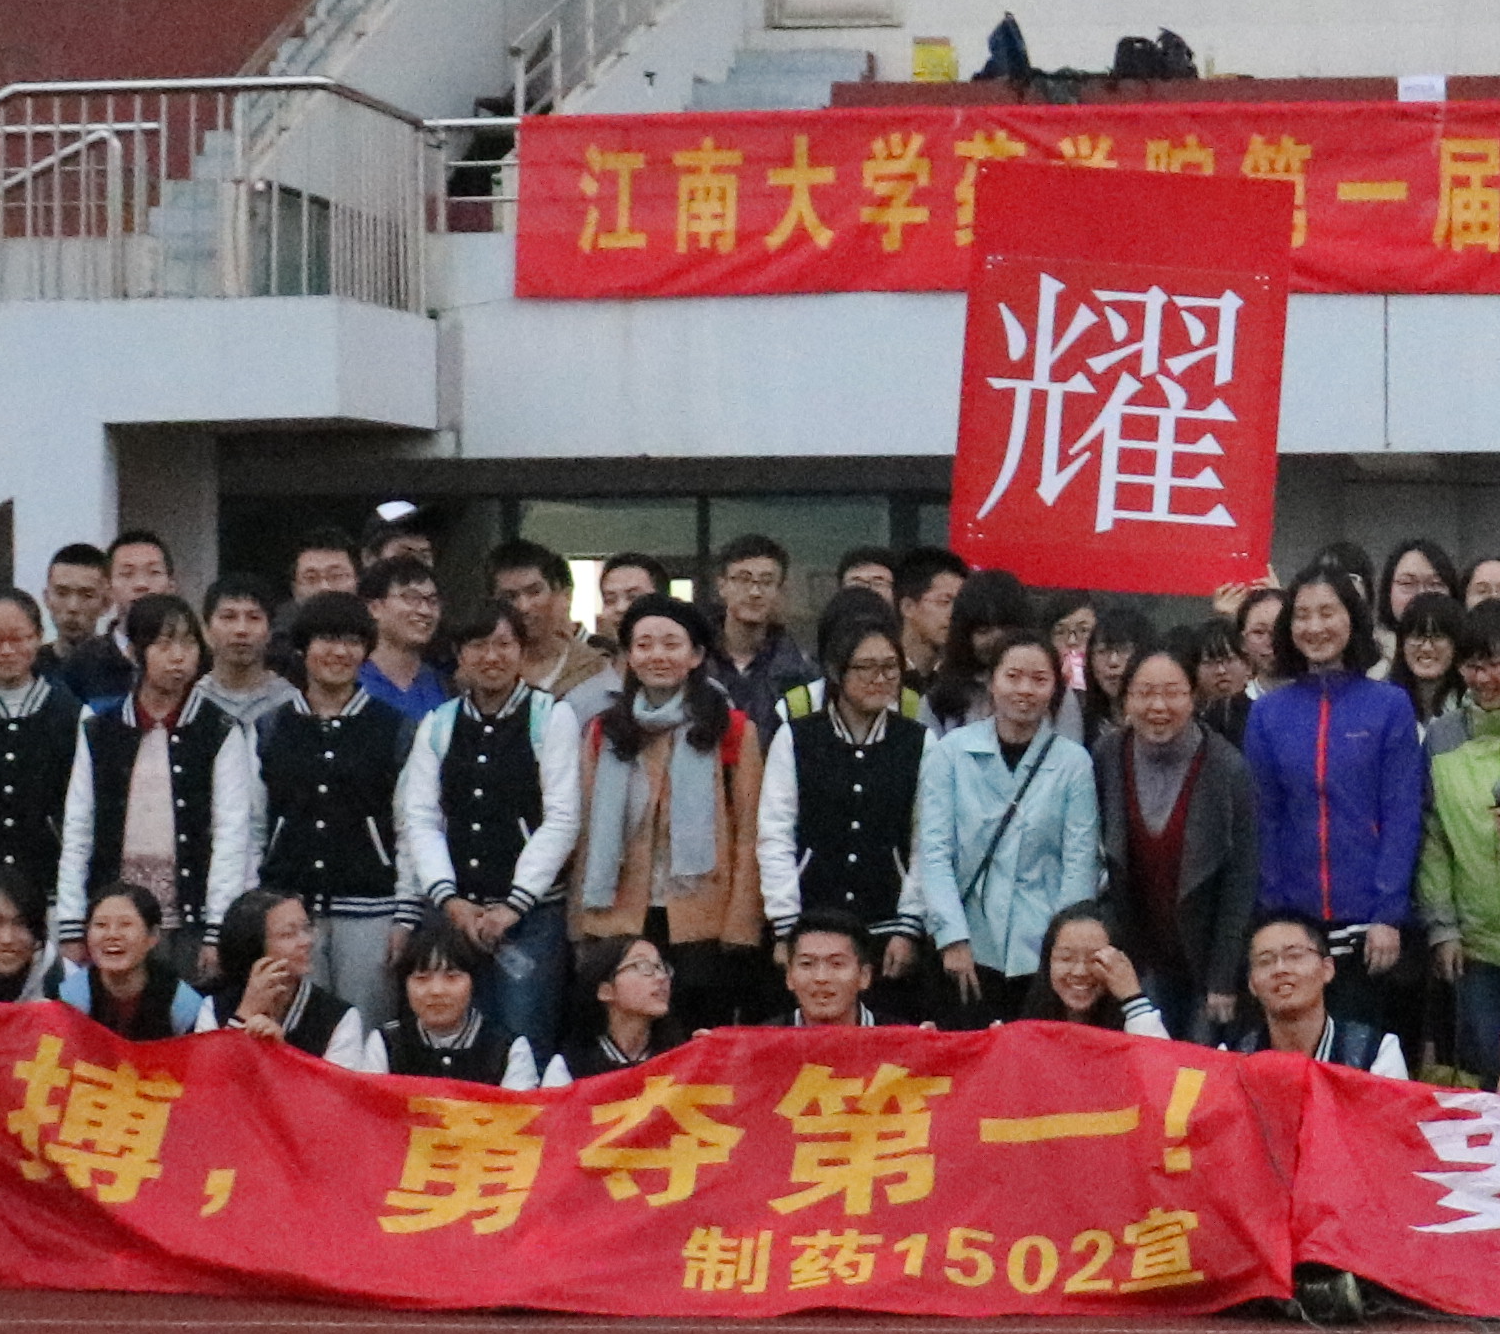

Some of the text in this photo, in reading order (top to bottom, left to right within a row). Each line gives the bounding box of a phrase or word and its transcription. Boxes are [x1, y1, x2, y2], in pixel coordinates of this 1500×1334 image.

[975, 271, 1246, 535] 耀
[679, 1208, 1206, 1296] 制药1502宣
